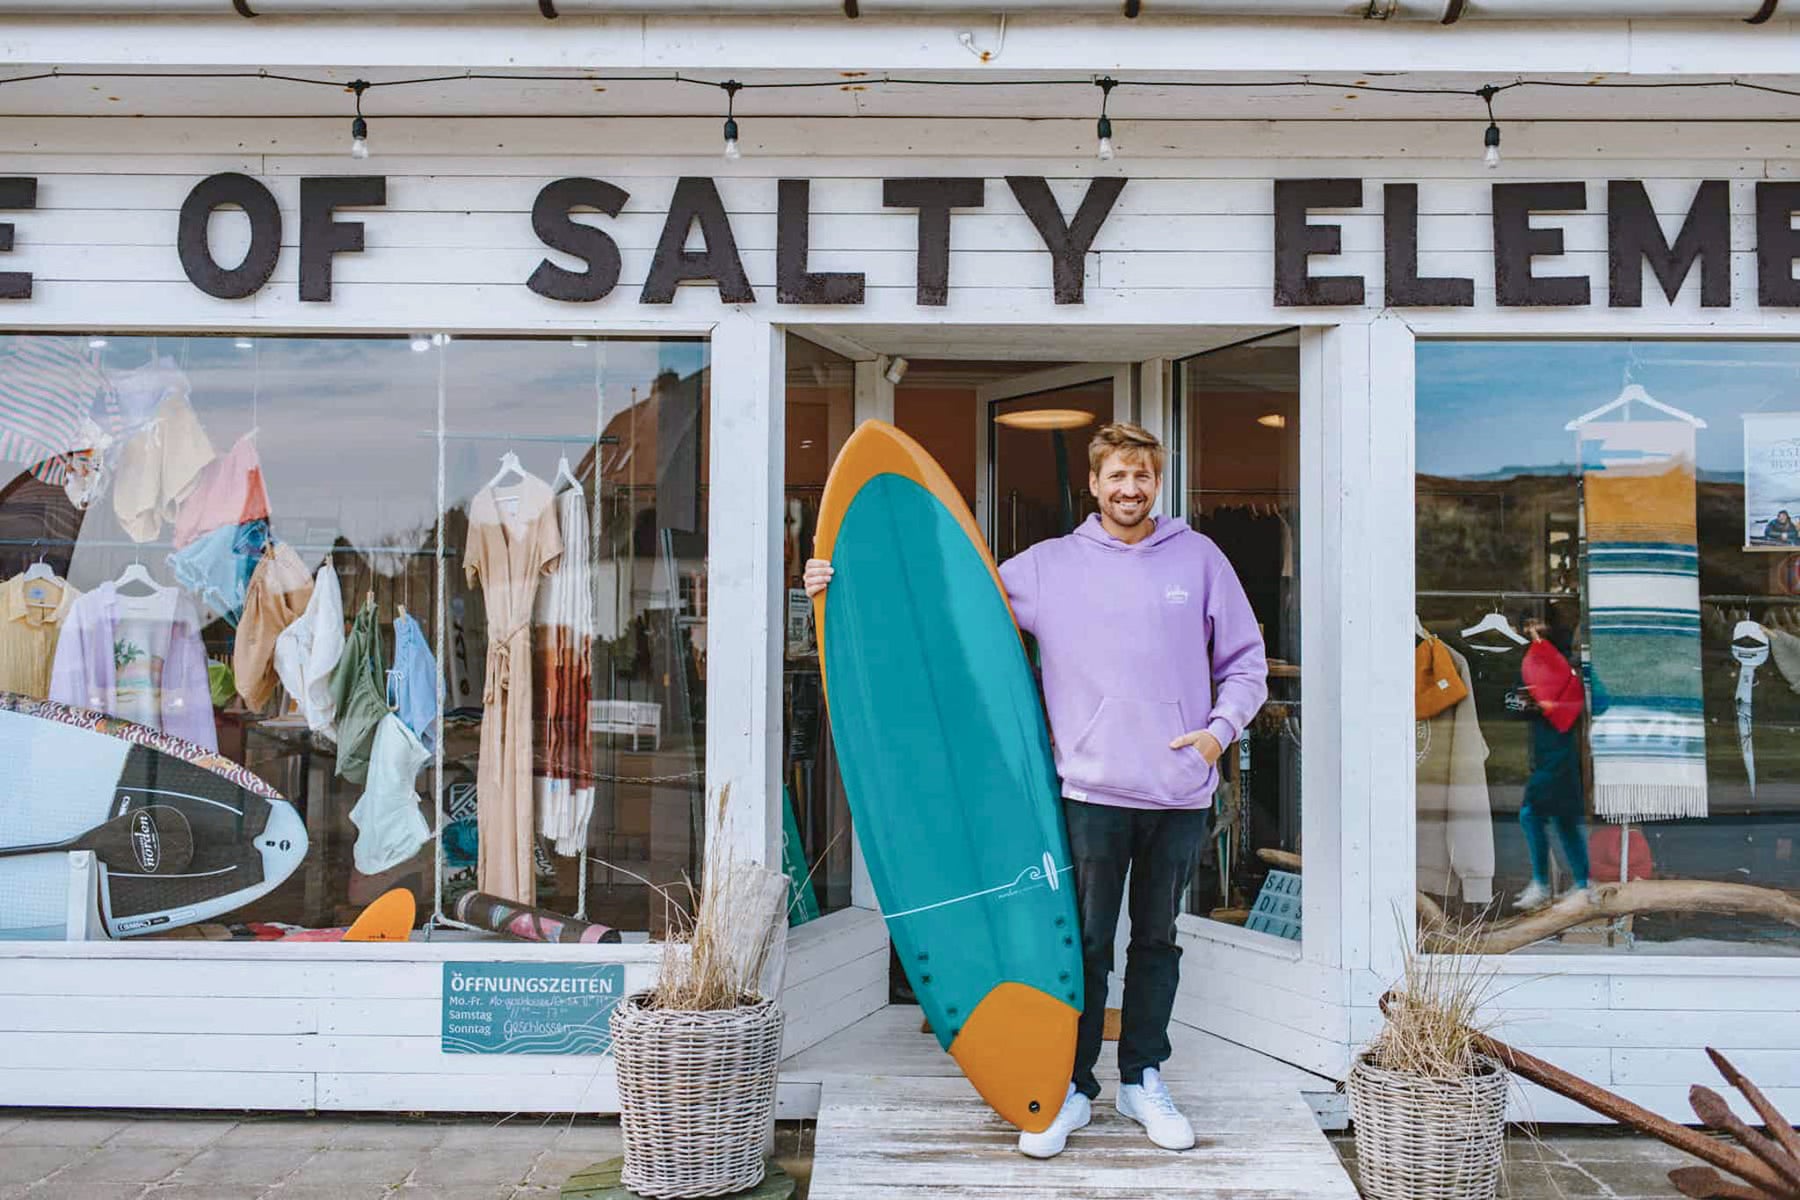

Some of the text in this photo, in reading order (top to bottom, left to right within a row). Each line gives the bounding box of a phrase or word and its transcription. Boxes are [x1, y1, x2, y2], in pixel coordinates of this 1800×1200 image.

[177, 172, 387, 302] OF
[526, 176, 1128, 306] SALTY
[134, 815, 156, 867] norden
[450, 971, 614, 994] ÖFFNUNGSZEITEN
[448, 1010, 493, 1022] Samstag
[448, 1024, 491, 1036] Sonntag
